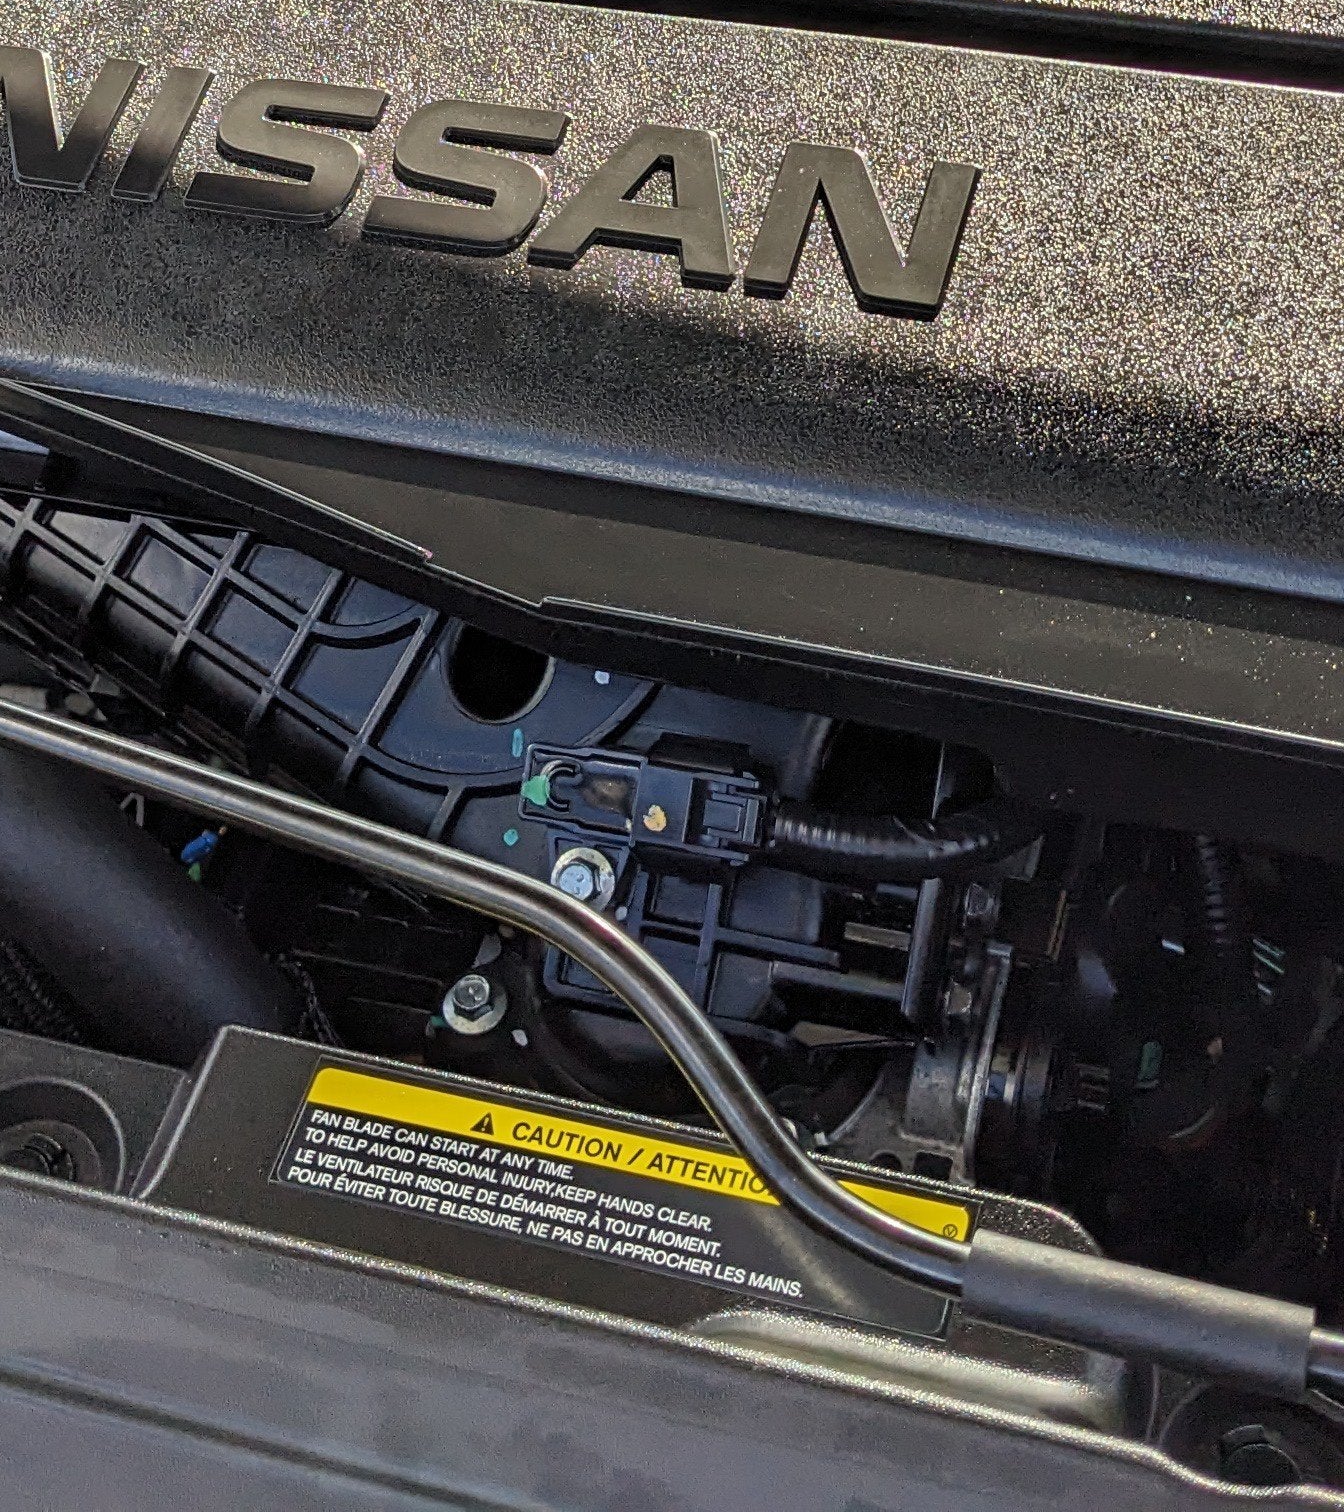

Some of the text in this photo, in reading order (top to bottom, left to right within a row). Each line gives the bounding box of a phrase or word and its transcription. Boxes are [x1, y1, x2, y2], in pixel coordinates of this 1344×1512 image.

[305, 1126, 327, 1144] TO
[327, 1132, 367, 1152] HELP
[367, 1142, 416, 1165] AVOID
[417, 1154, 499, 1184] PERSONAL
[599, 1193, 656, 1219] HANDS
[658, 1206, 713, 1233] CLEAR.
[311, 1109, 575, 1181] FAN BLADE CAN START AT ANY TIME.
[511, 1121, 774, 1196] CAUTION / ATTENTIO
[287, 1166, 804, 1298] POUR ÉVITER TOUTE BLESSURE, NE PAS EN APPROCHER LES MAINS.
[294, 1148, 723, 1258] LE VENTILATEUR RISQUE DE DÉMARRER À TOUT MOMENT.
